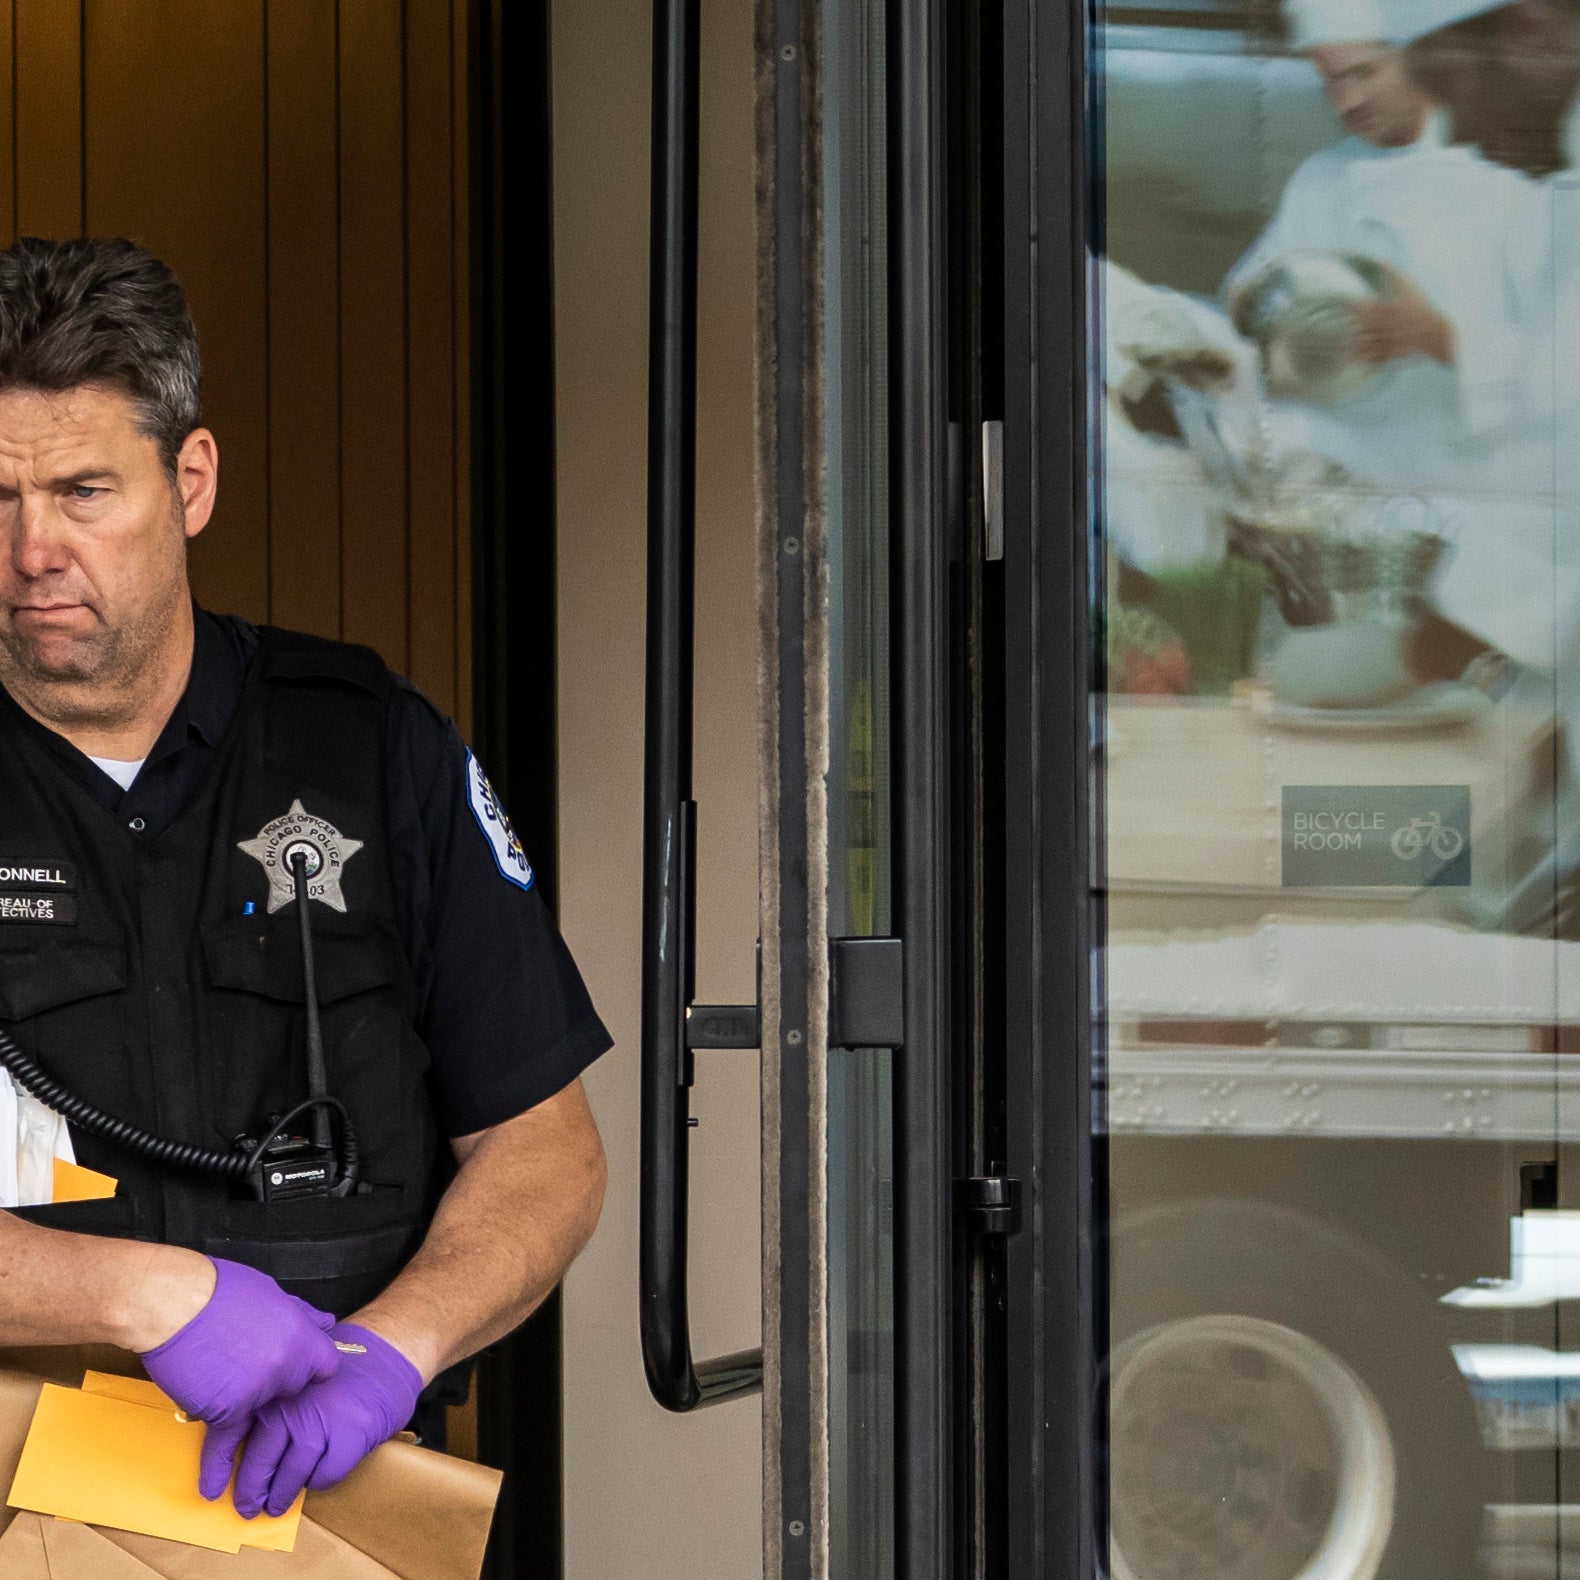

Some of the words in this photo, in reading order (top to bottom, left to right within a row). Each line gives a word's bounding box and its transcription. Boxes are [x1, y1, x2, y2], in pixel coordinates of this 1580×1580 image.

[263, 816, 295, 836] POLICE
[296, 815, 336, 837] OFFICER
[1294, 812, 1385, 830] BICYCLE
[266, 825, 302, 868] CHICAGO
[309, 829, 340, 868] POLICE
[1294, 832, 1362, 851] ROOM
